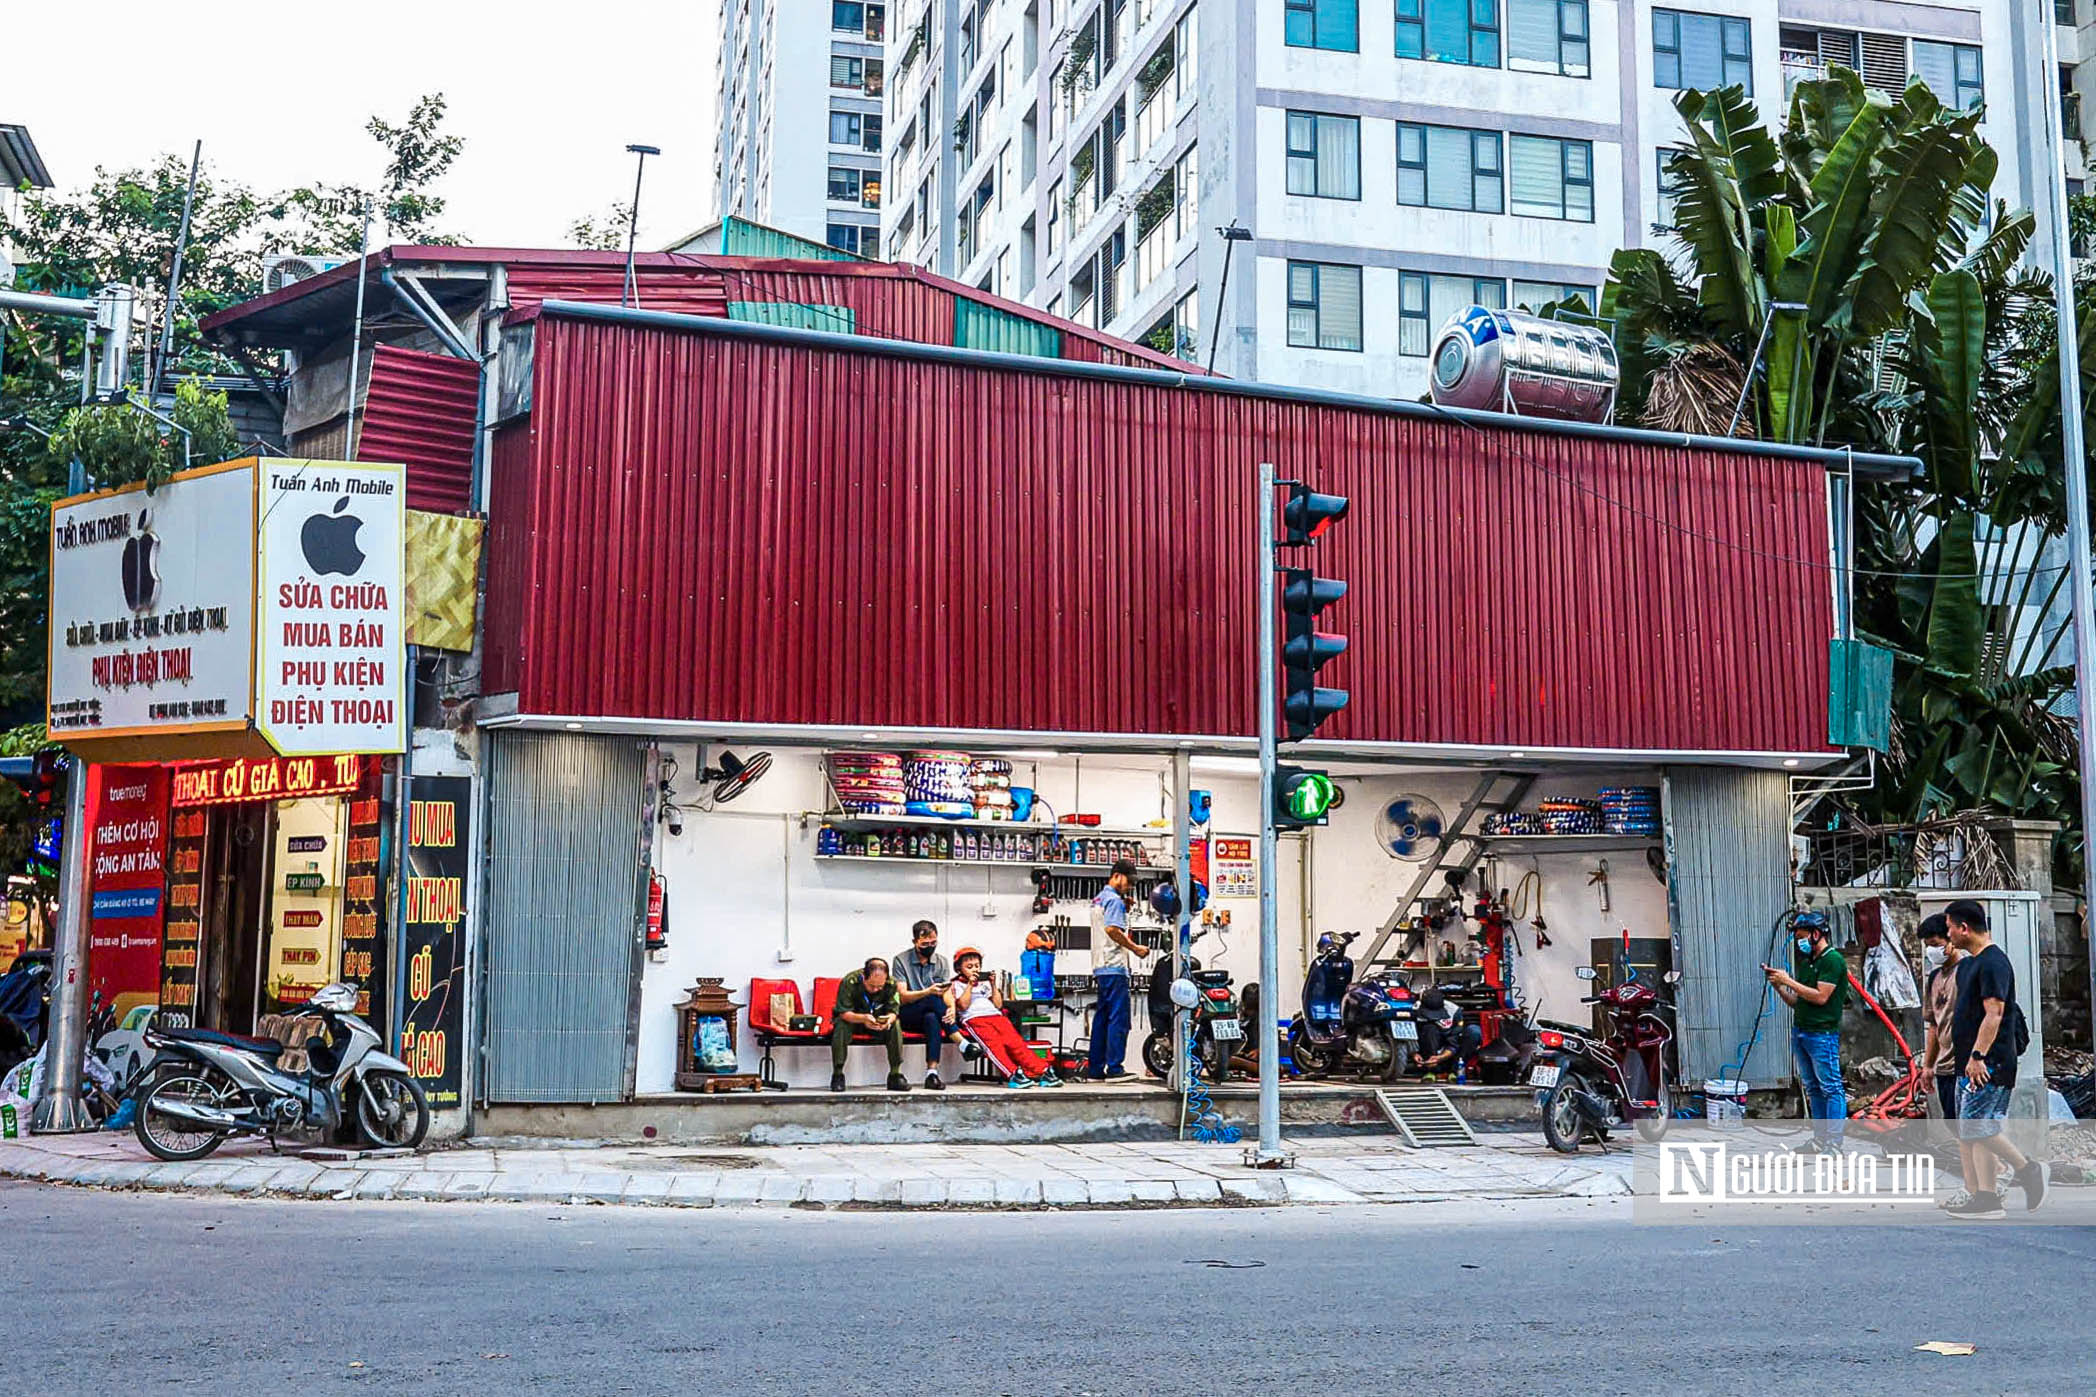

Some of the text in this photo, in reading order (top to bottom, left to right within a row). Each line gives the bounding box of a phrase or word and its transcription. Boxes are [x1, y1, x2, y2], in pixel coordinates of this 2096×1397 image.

[272, 474, 394, 495] Tuấn Anh Mobile
[279, 576, 388, 610] SỬA CHỮA
[283, 618, 384, 648] MUA BÁN
[92, 645, 193, 693] PHỤ KIỆN ĐIỆN THOẠI
[282, 656, 384, 691] PHỤ KIỆN
[271, 694, 394, 730] ĐIỆN THOẠI
[287, 759, 314, 790] CAO
[123, 819, 138, 842] CƠ
[141, 816, 160, 845] HỘI
[424, 801, 456, 847] MUA
[95, 852, 119, 879] ỘNG
[120, 853, 135, 872] AN
[406, 876, 461, 934] N THOẠI
[410, 944, 432, 1001] CŨ
[417, 1030, 446, 1079] CAO
